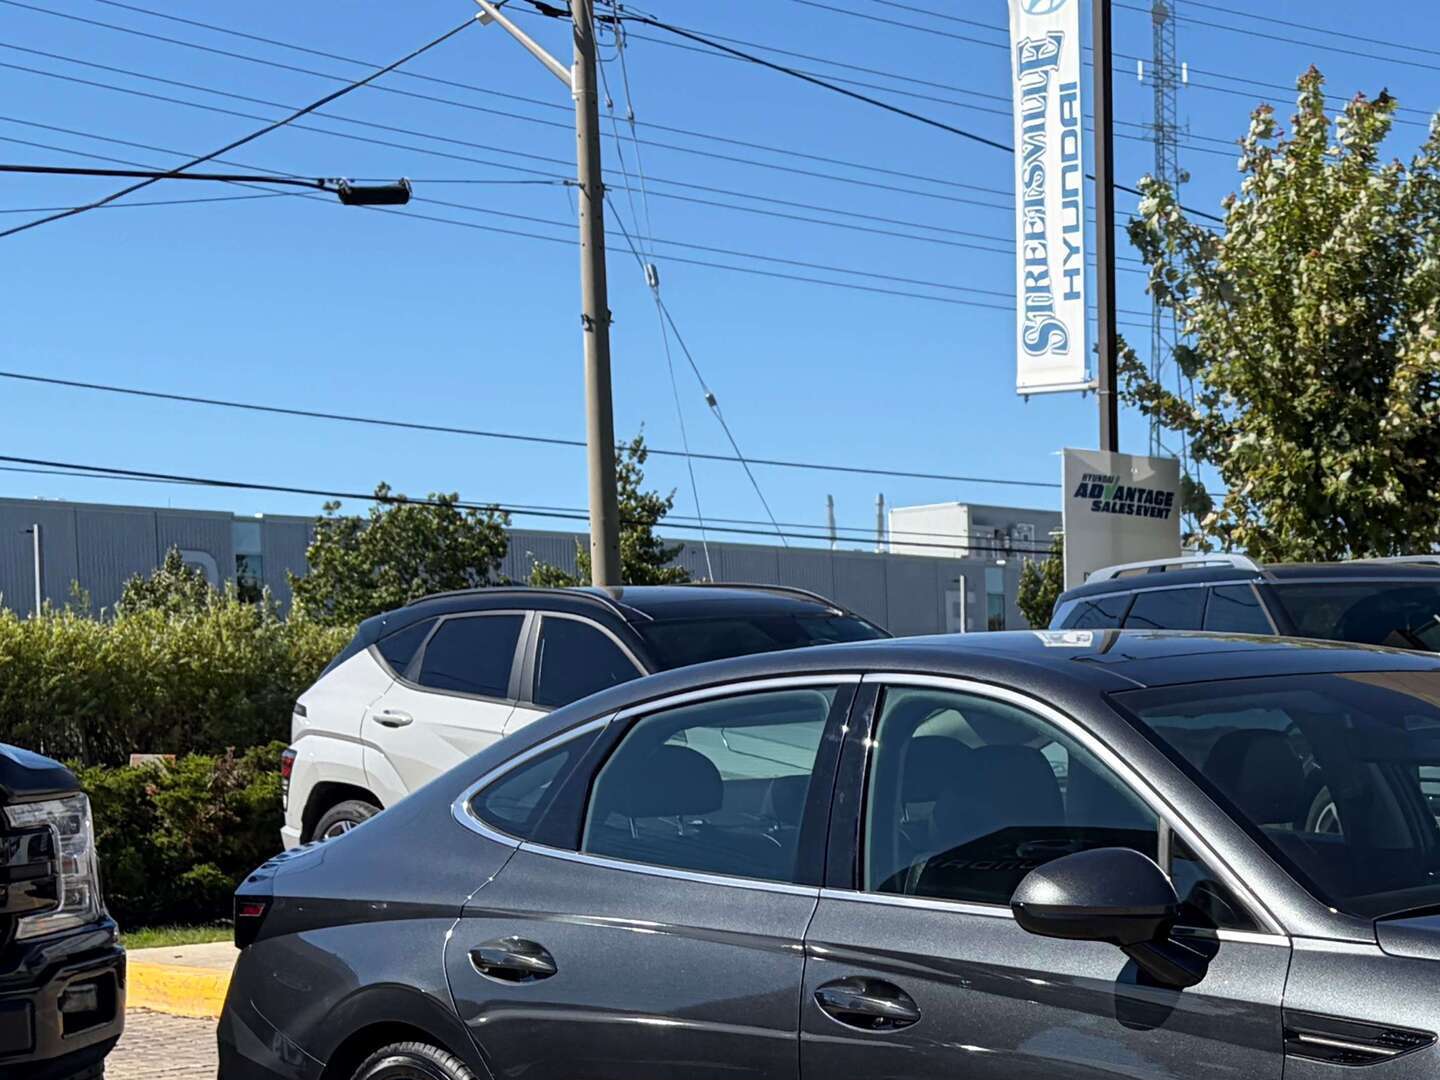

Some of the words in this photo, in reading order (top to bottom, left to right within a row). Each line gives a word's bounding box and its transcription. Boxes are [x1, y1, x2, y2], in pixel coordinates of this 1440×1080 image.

[1016, 31, 1069, 357] STREETSVILLE
[1059, 81, 1081, 301] HYUNDAI
[1091, 500, 1135, 516] SALES
[1135, 505, 1171, 520] EVENT
